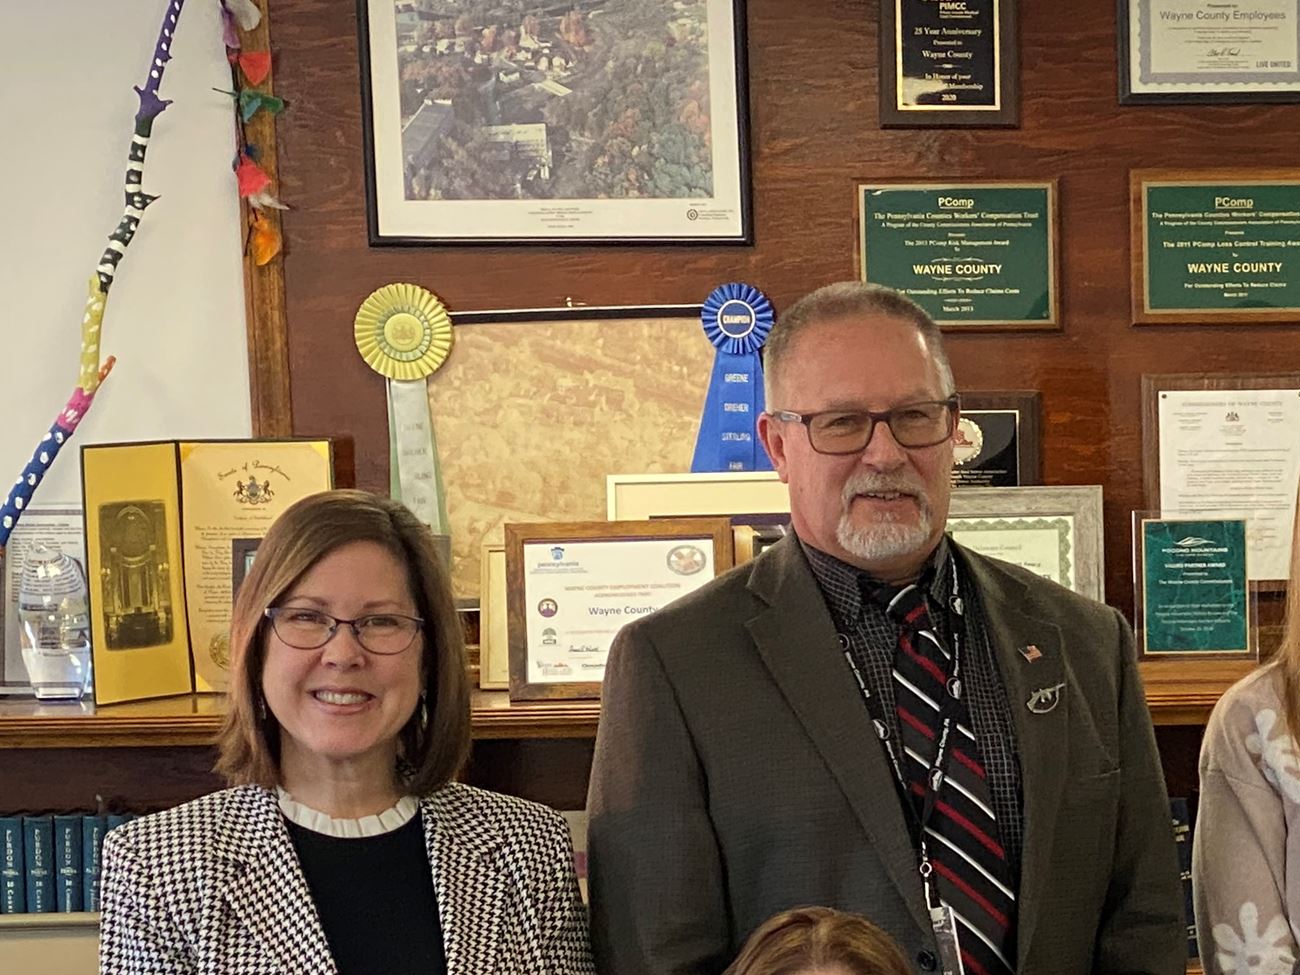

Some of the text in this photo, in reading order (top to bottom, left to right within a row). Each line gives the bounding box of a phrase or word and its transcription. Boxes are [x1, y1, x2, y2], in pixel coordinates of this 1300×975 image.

[1160, 11, 1286, 21] Wayne County Employees
[924, 27, 940, 35] Year
[941, 27, 982, 36] Anniversary
[922, 50, 973, 60] Wayne County
[938, 197, 974, 208] PComp
[1215, 197, 1253, 208] PComp
[913, 264, 1002, 275] WAYNE COUNTY
[1187, 262, 1282, 273] WAYNE COUNTY
[588, 607, 621, 616] Wayne
